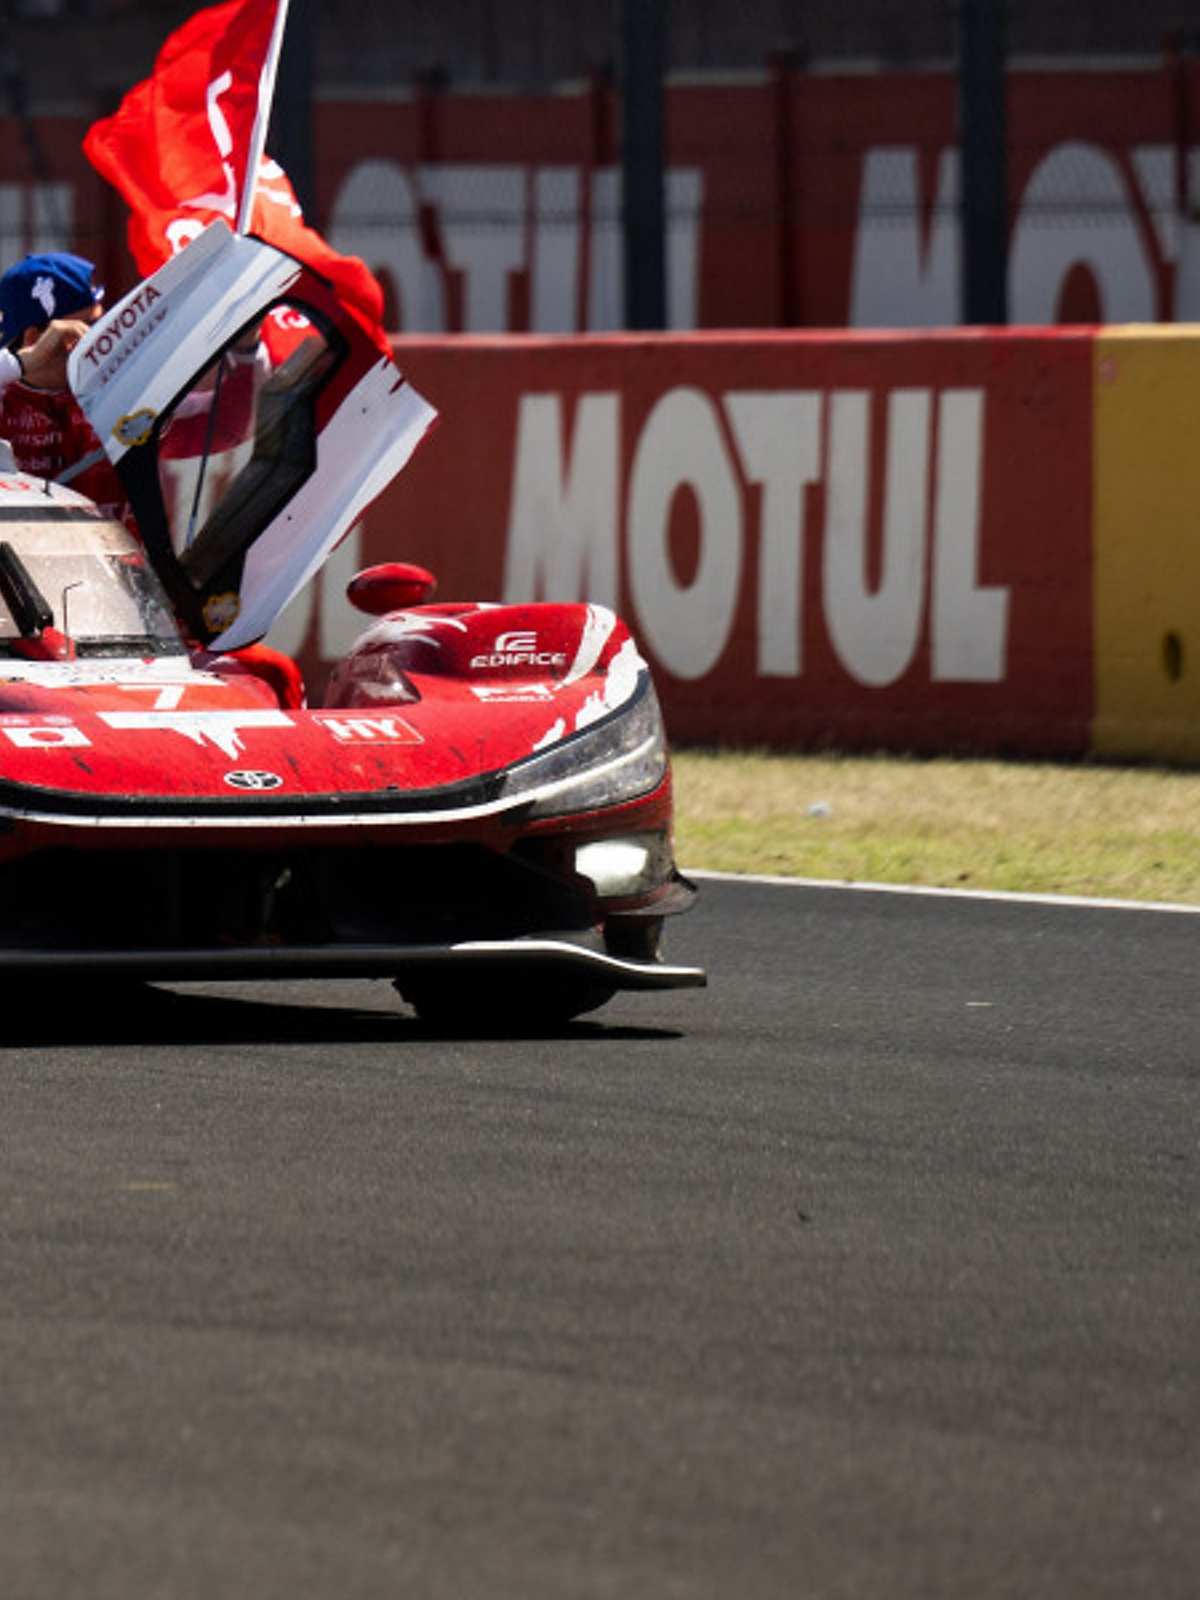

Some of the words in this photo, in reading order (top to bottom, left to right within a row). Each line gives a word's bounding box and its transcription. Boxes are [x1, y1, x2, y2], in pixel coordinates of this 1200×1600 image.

[84, 285, 161, 367] TOYOTA
[506, 384, 1010, 688] MOTUL
[469, 652, 567, 669] EDIFICE
[116, 684, 185, 710] 7
[321, 717, 402, 739] HY
